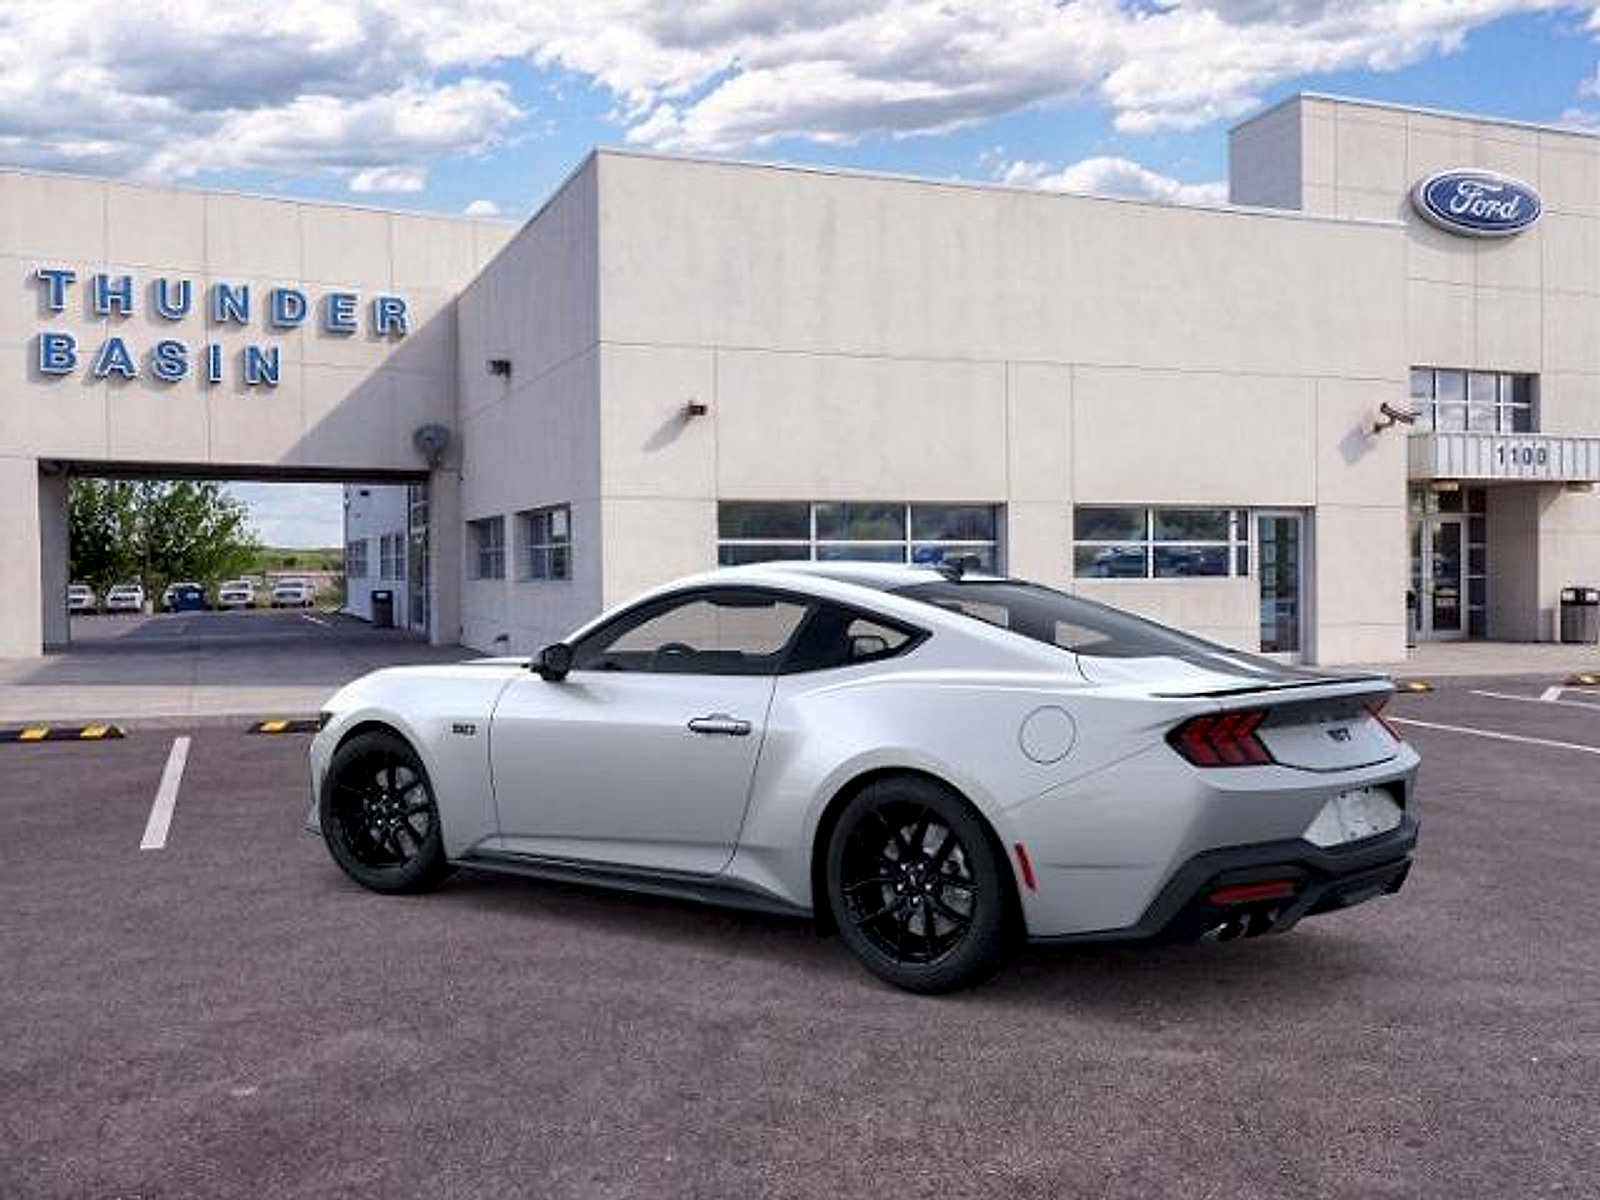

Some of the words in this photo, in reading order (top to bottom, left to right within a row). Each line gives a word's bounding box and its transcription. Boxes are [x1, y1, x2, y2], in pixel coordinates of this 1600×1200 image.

[1450, 180, 1520, 219] Ford
[37, 268, 410, 336] THUNDER
[38, 331, 282, 385] BASIN
[1497, 446, 1547, 465] 1100
